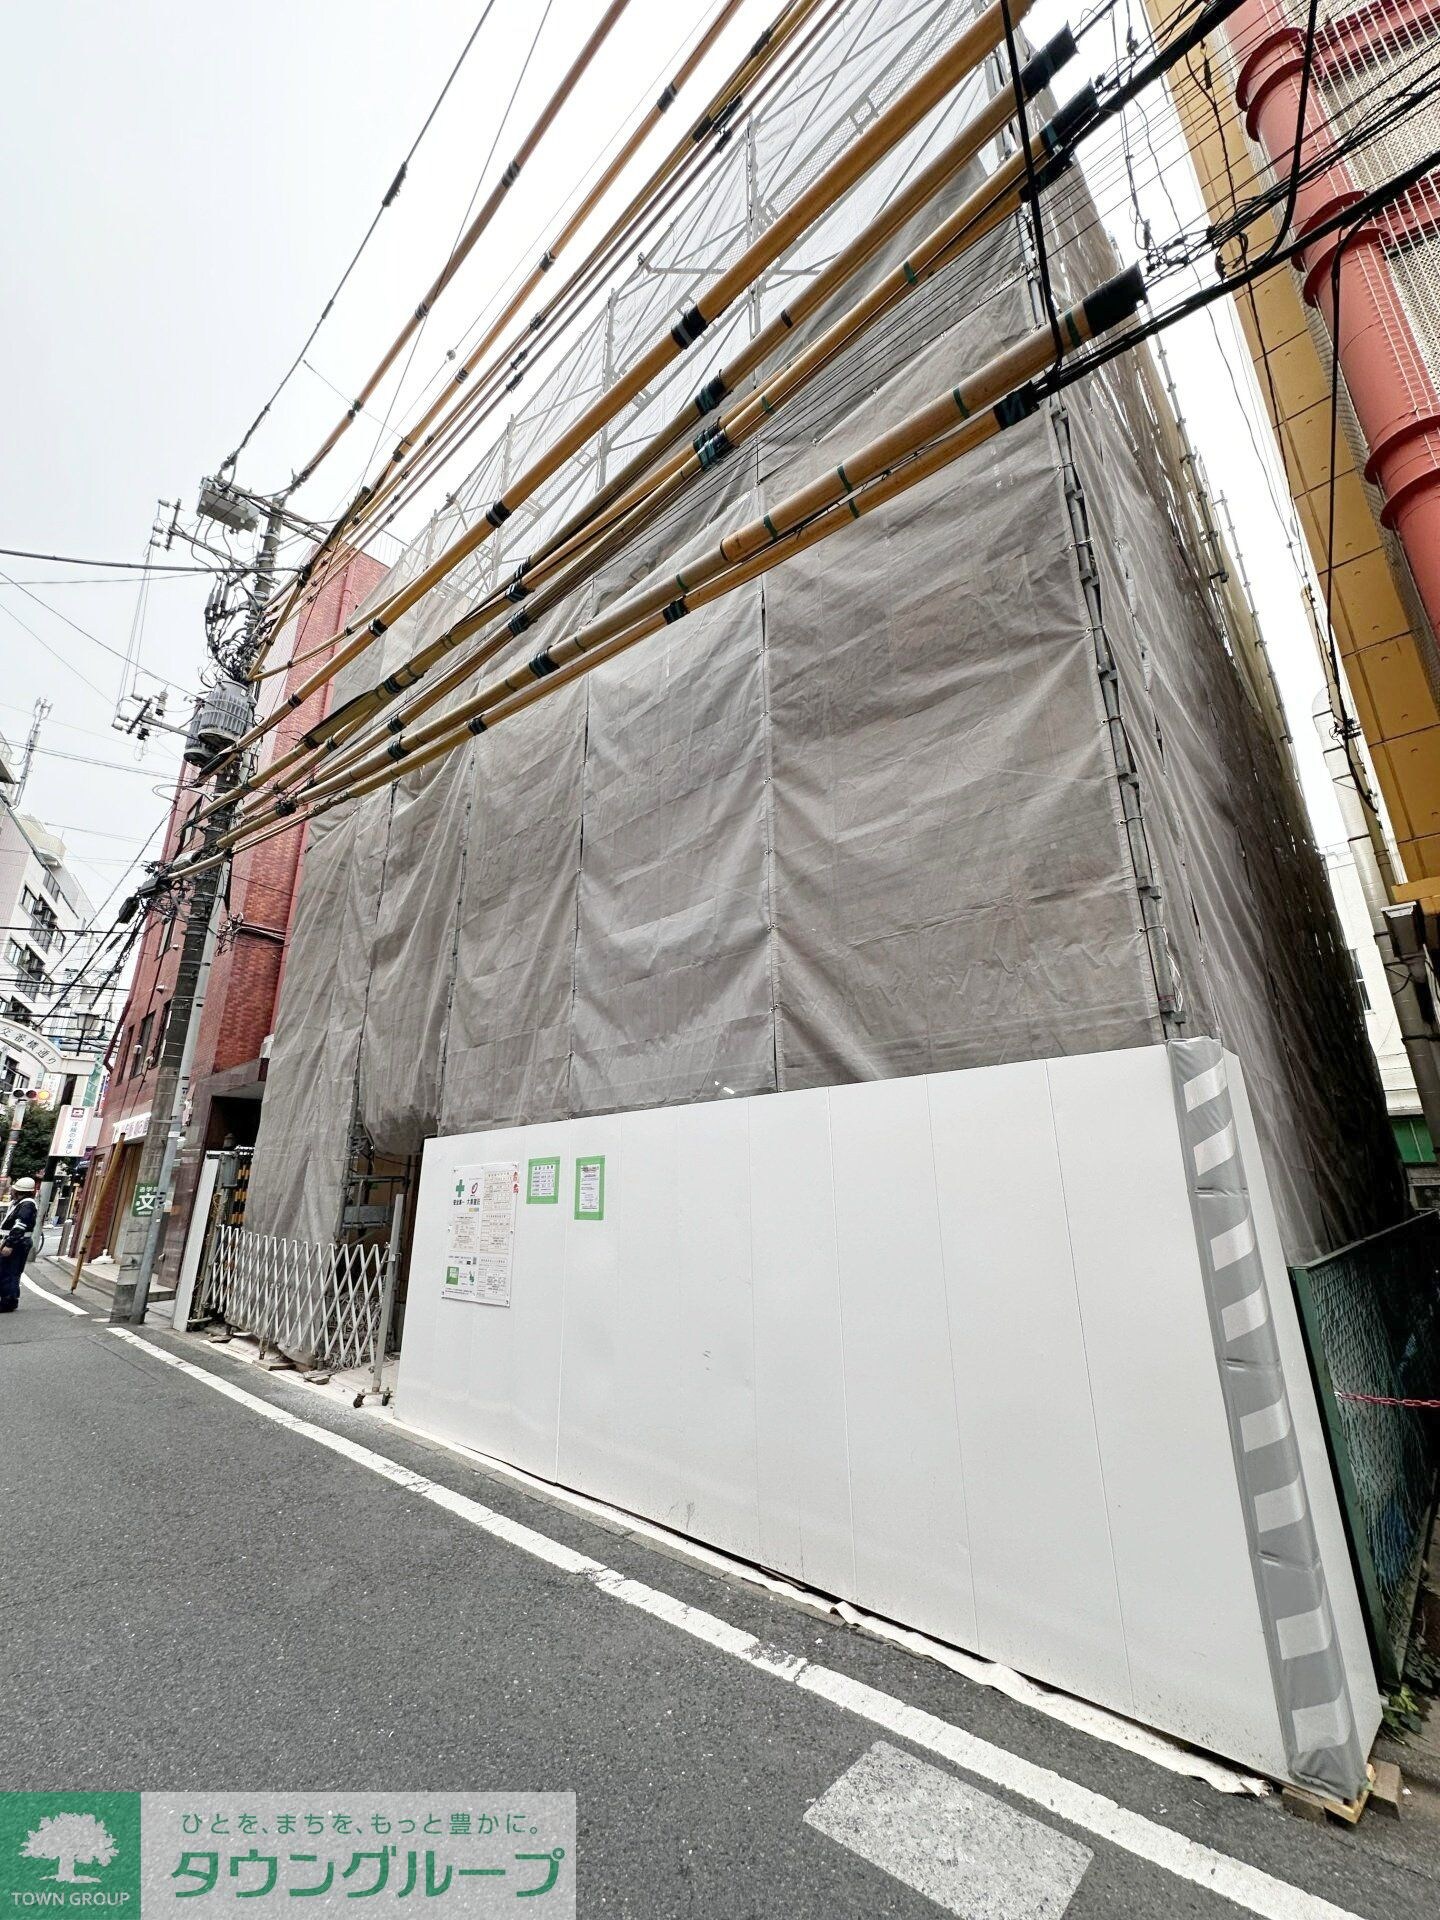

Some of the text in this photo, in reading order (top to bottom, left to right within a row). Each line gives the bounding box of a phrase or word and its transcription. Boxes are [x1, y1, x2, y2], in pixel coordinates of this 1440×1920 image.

[0, 1026, 57, 1065] 交番横通り
